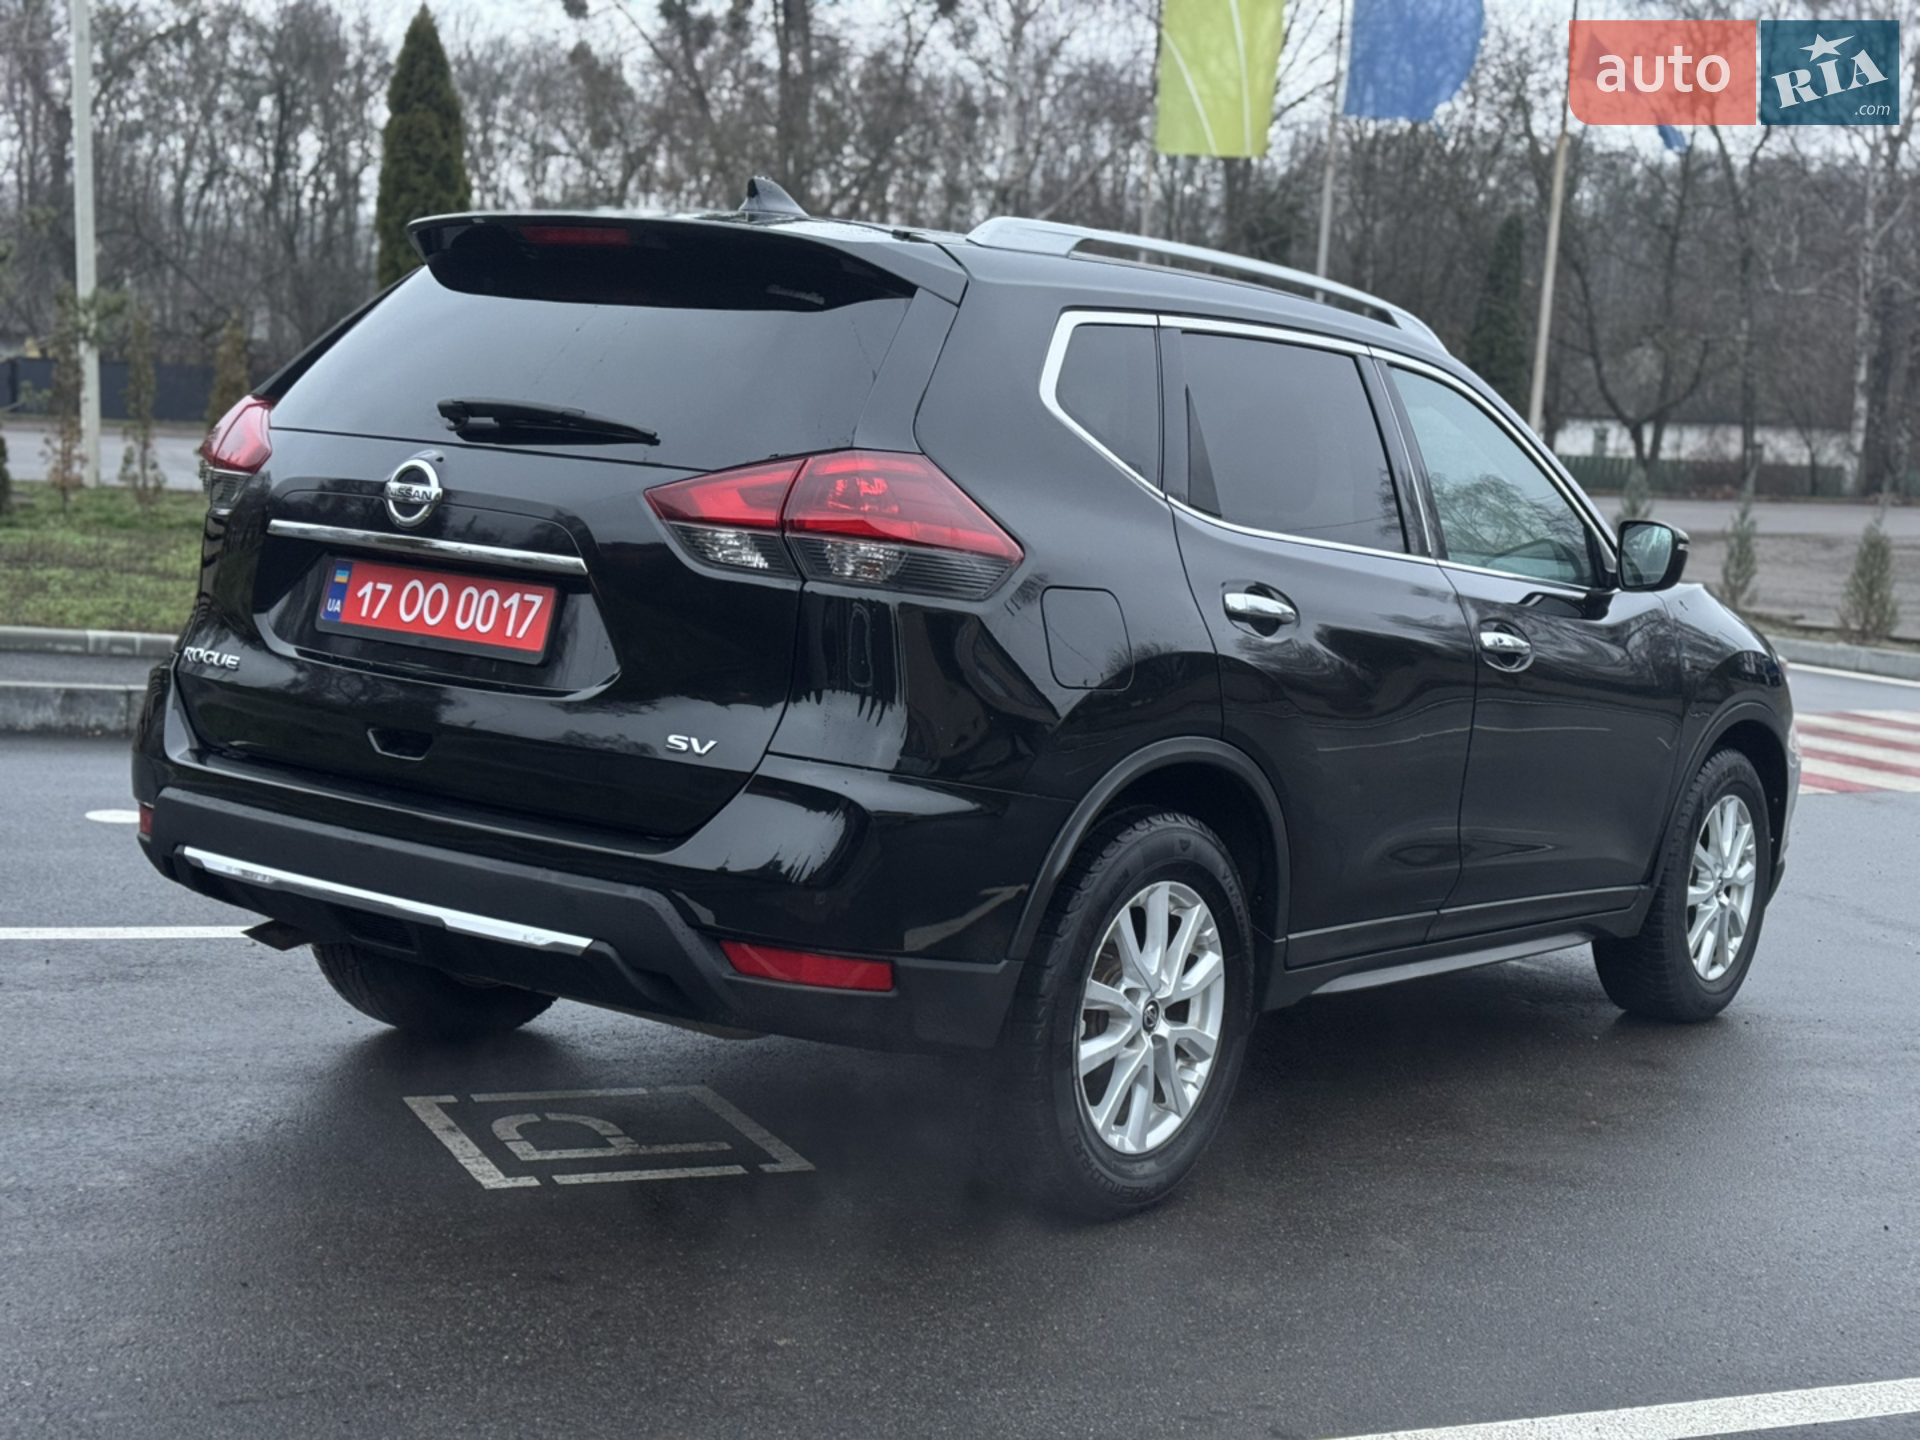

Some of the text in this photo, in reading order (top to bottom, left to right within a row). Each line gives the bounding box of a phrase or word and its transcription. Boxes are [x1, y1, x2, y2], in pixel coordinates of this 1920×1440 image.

[388, 485, 433, 501] NISSAN
[327, 598, 341, 612] UA
[357, 581, 393, 619] 17
[455, 586, 544, 639] 0017
[183, 646, 240, 670] ROGUE
[665, 734, 718, 755] SV
